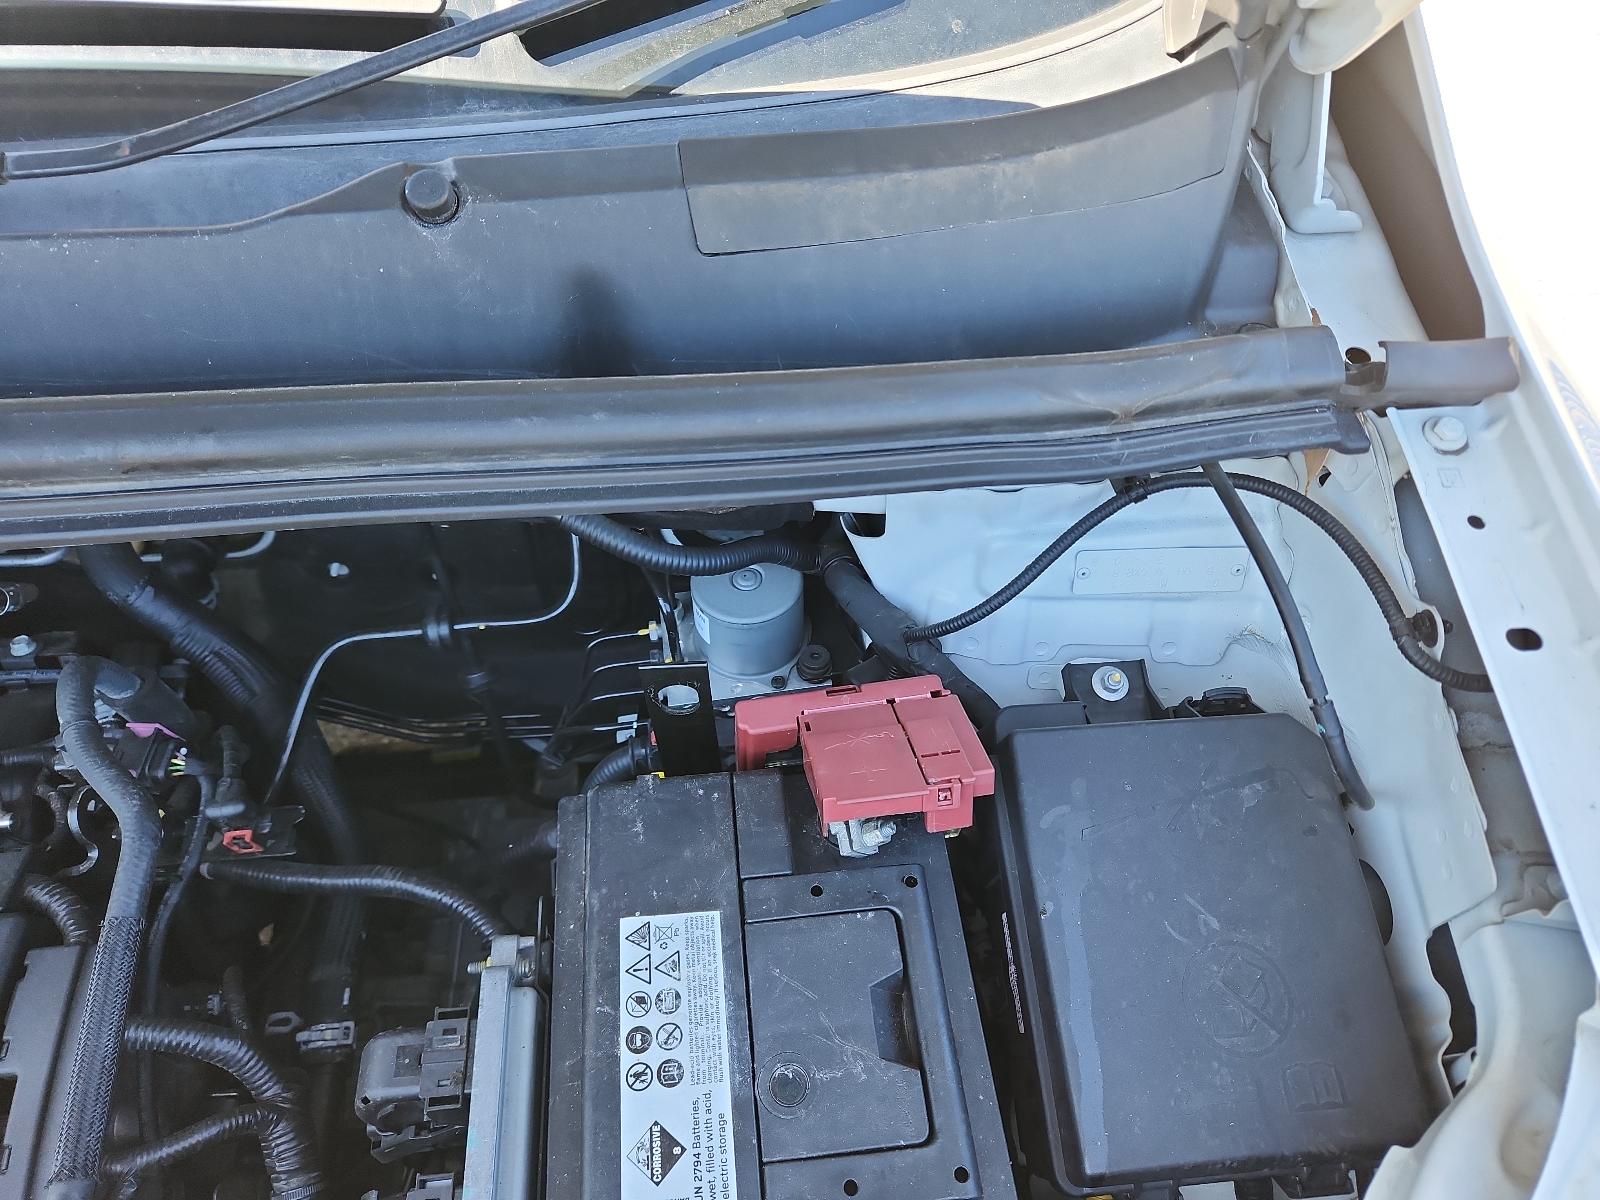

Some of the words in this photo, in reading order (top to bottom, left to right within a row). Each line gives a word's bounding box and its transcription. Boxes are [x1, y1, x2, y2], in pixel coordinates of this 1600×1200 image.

[674, 928, 679, 936] Pb
[702, 1089, 712, 1114] acid,
[690, 1096, 701, 1149] Batteries,
[704, 1118, 714, 1142] with
[717, 1112, 728, 1155] storage
[652, 1124, 662, 1182] CORROSIVE
[672, 1146, 682, 1155] 8
[704, 1146, 715, 1173] filled
[692, 1152, 702, 1182] 2794
[719, 1158, 730, 1200] electric
[694, 1186, 703, 1200] UN
[706, 1176, 717, 1200] wet,
